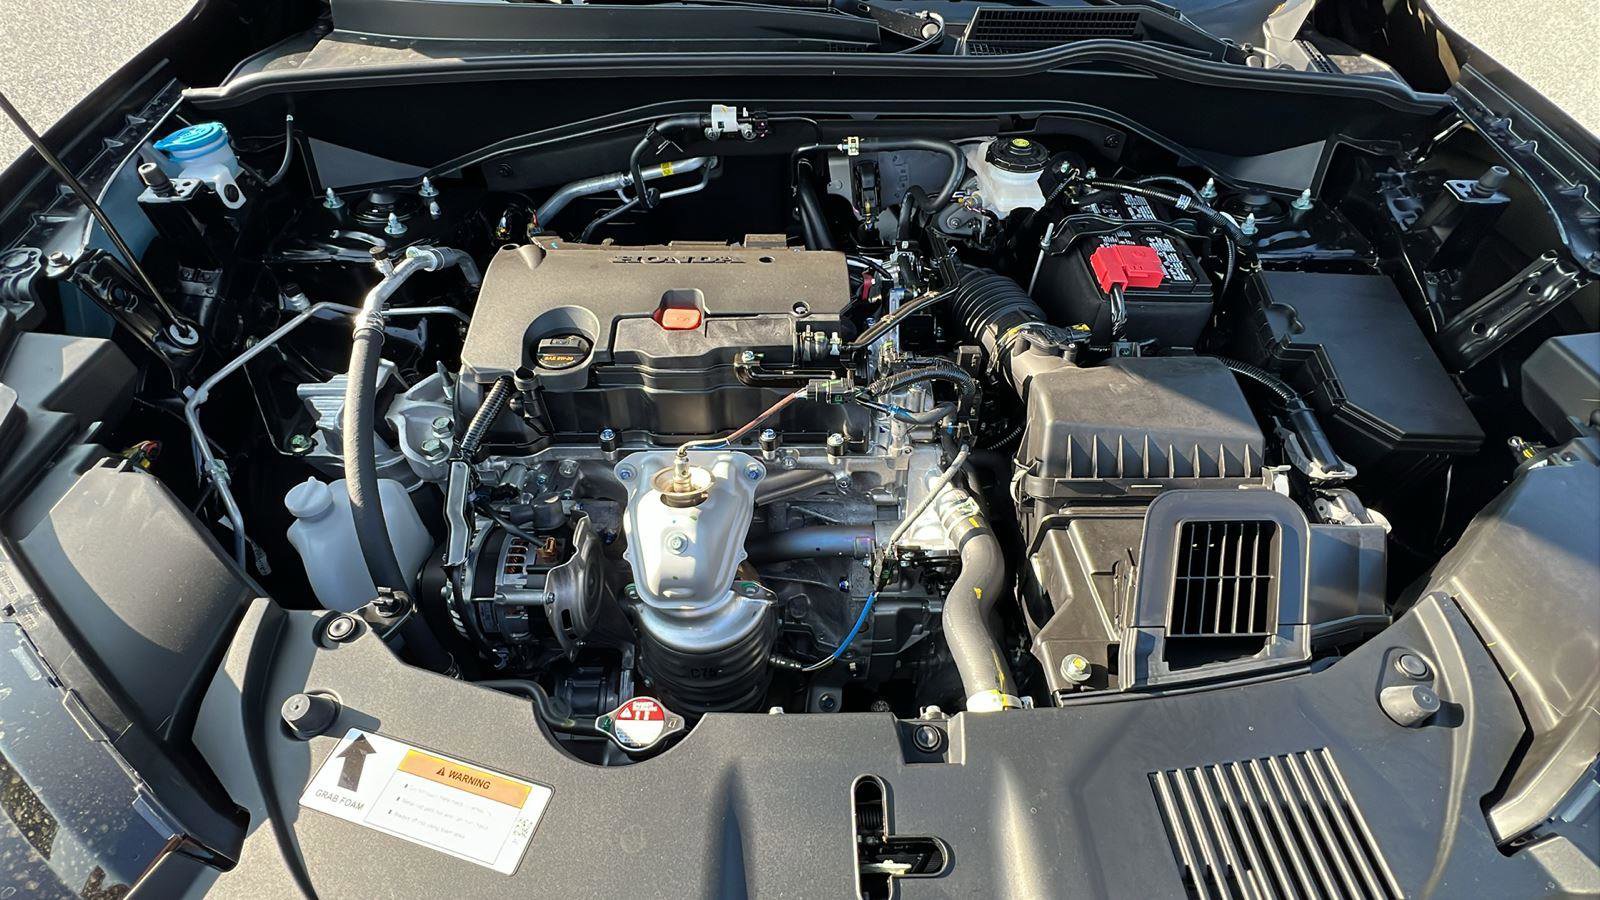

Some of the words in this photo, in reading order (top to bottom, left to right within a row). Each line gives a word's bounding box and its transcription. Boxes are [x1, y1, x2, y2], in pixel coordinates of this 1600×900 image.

[448, 769, 491, 790] WARNING
[315, 788, 339, 803] GRAB
[339, 797, 365, 811] FOAM
